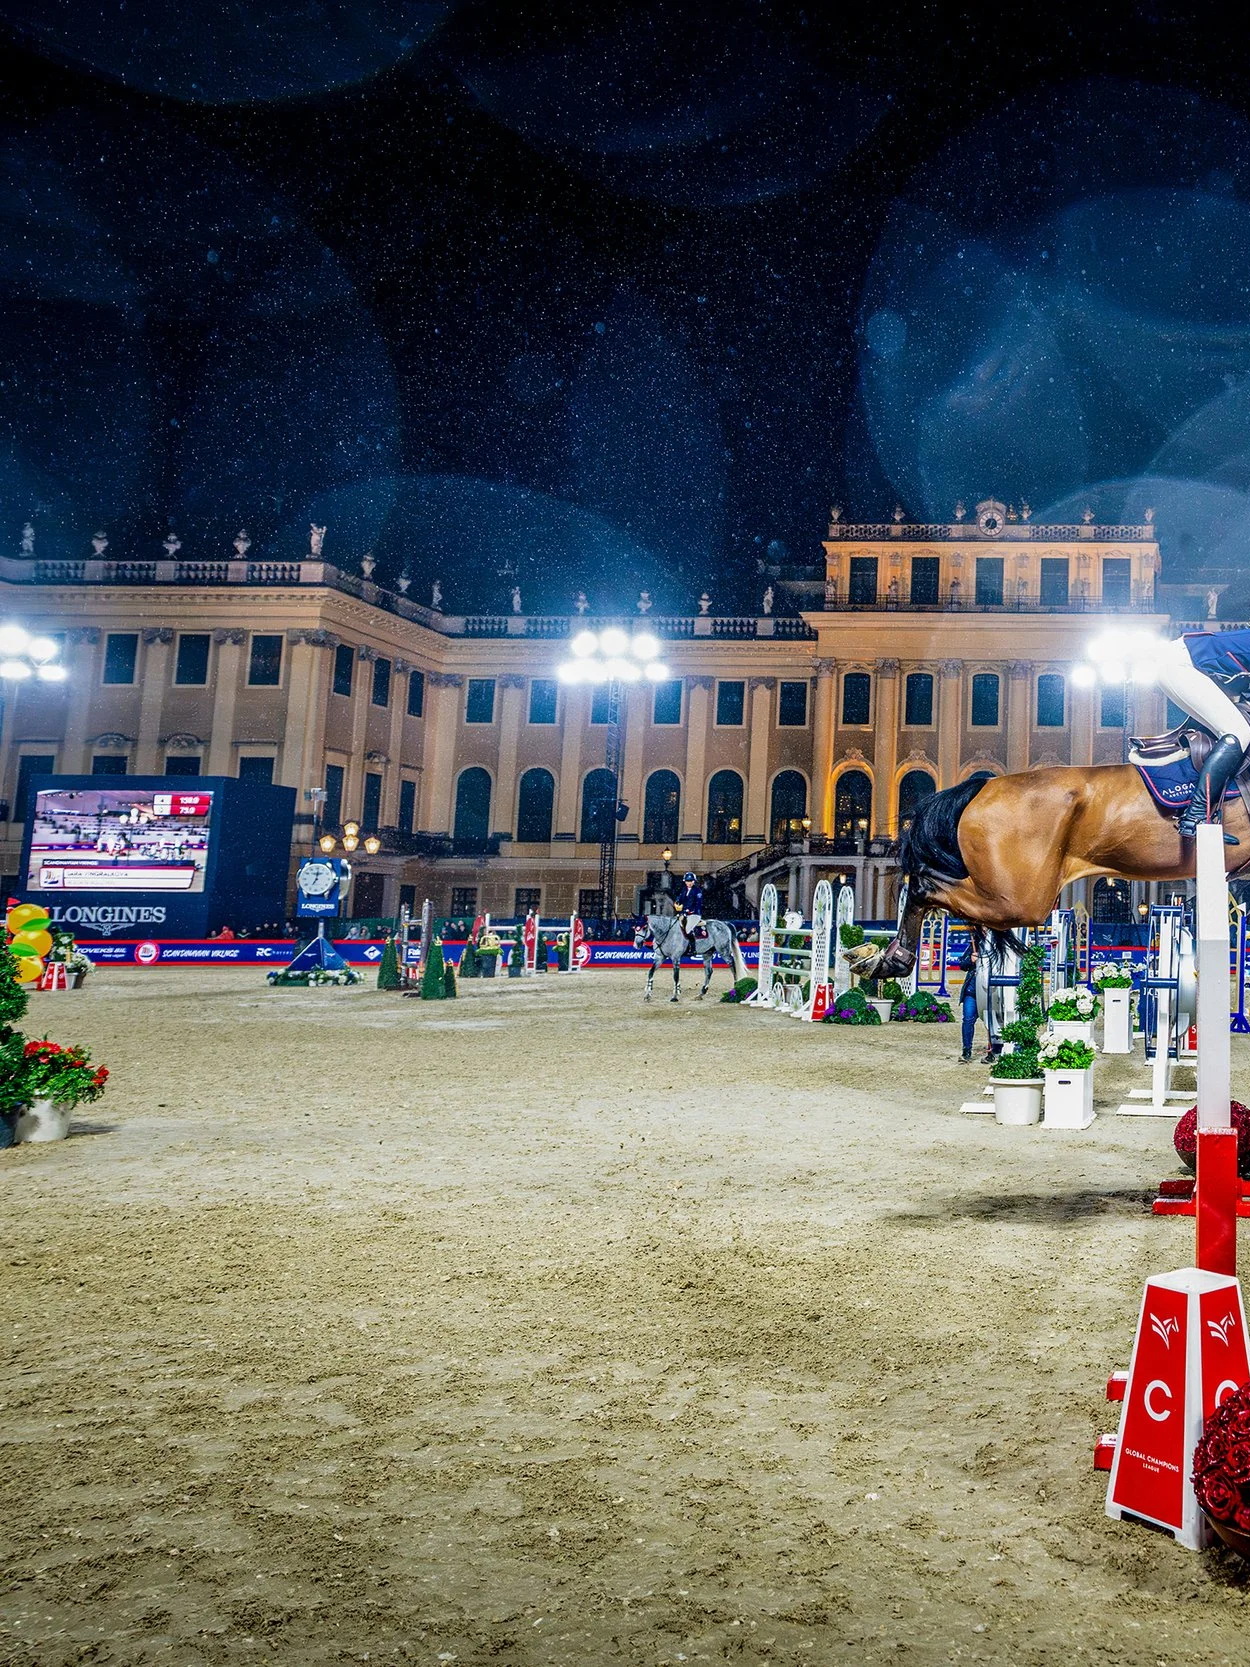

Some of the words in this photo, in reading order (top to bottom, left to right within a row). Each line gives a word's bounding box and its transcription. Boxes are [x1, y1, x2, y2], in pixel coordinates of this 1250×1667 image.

[1162, 782, 1196, 796] ALOGA
[52, 906, 166, 923] LONGINES
[256, 947, 273, 957] RC
[817, 998, 824, 1007] 8
[1143, 1379, 1173, 1422] C
[1125, 1448, 1146, 1461] GLOBAL
[1146, 1455, 1180, 1473] CHAMPIONS
[1142, 1463, 1160, 1473] LEAGUE
